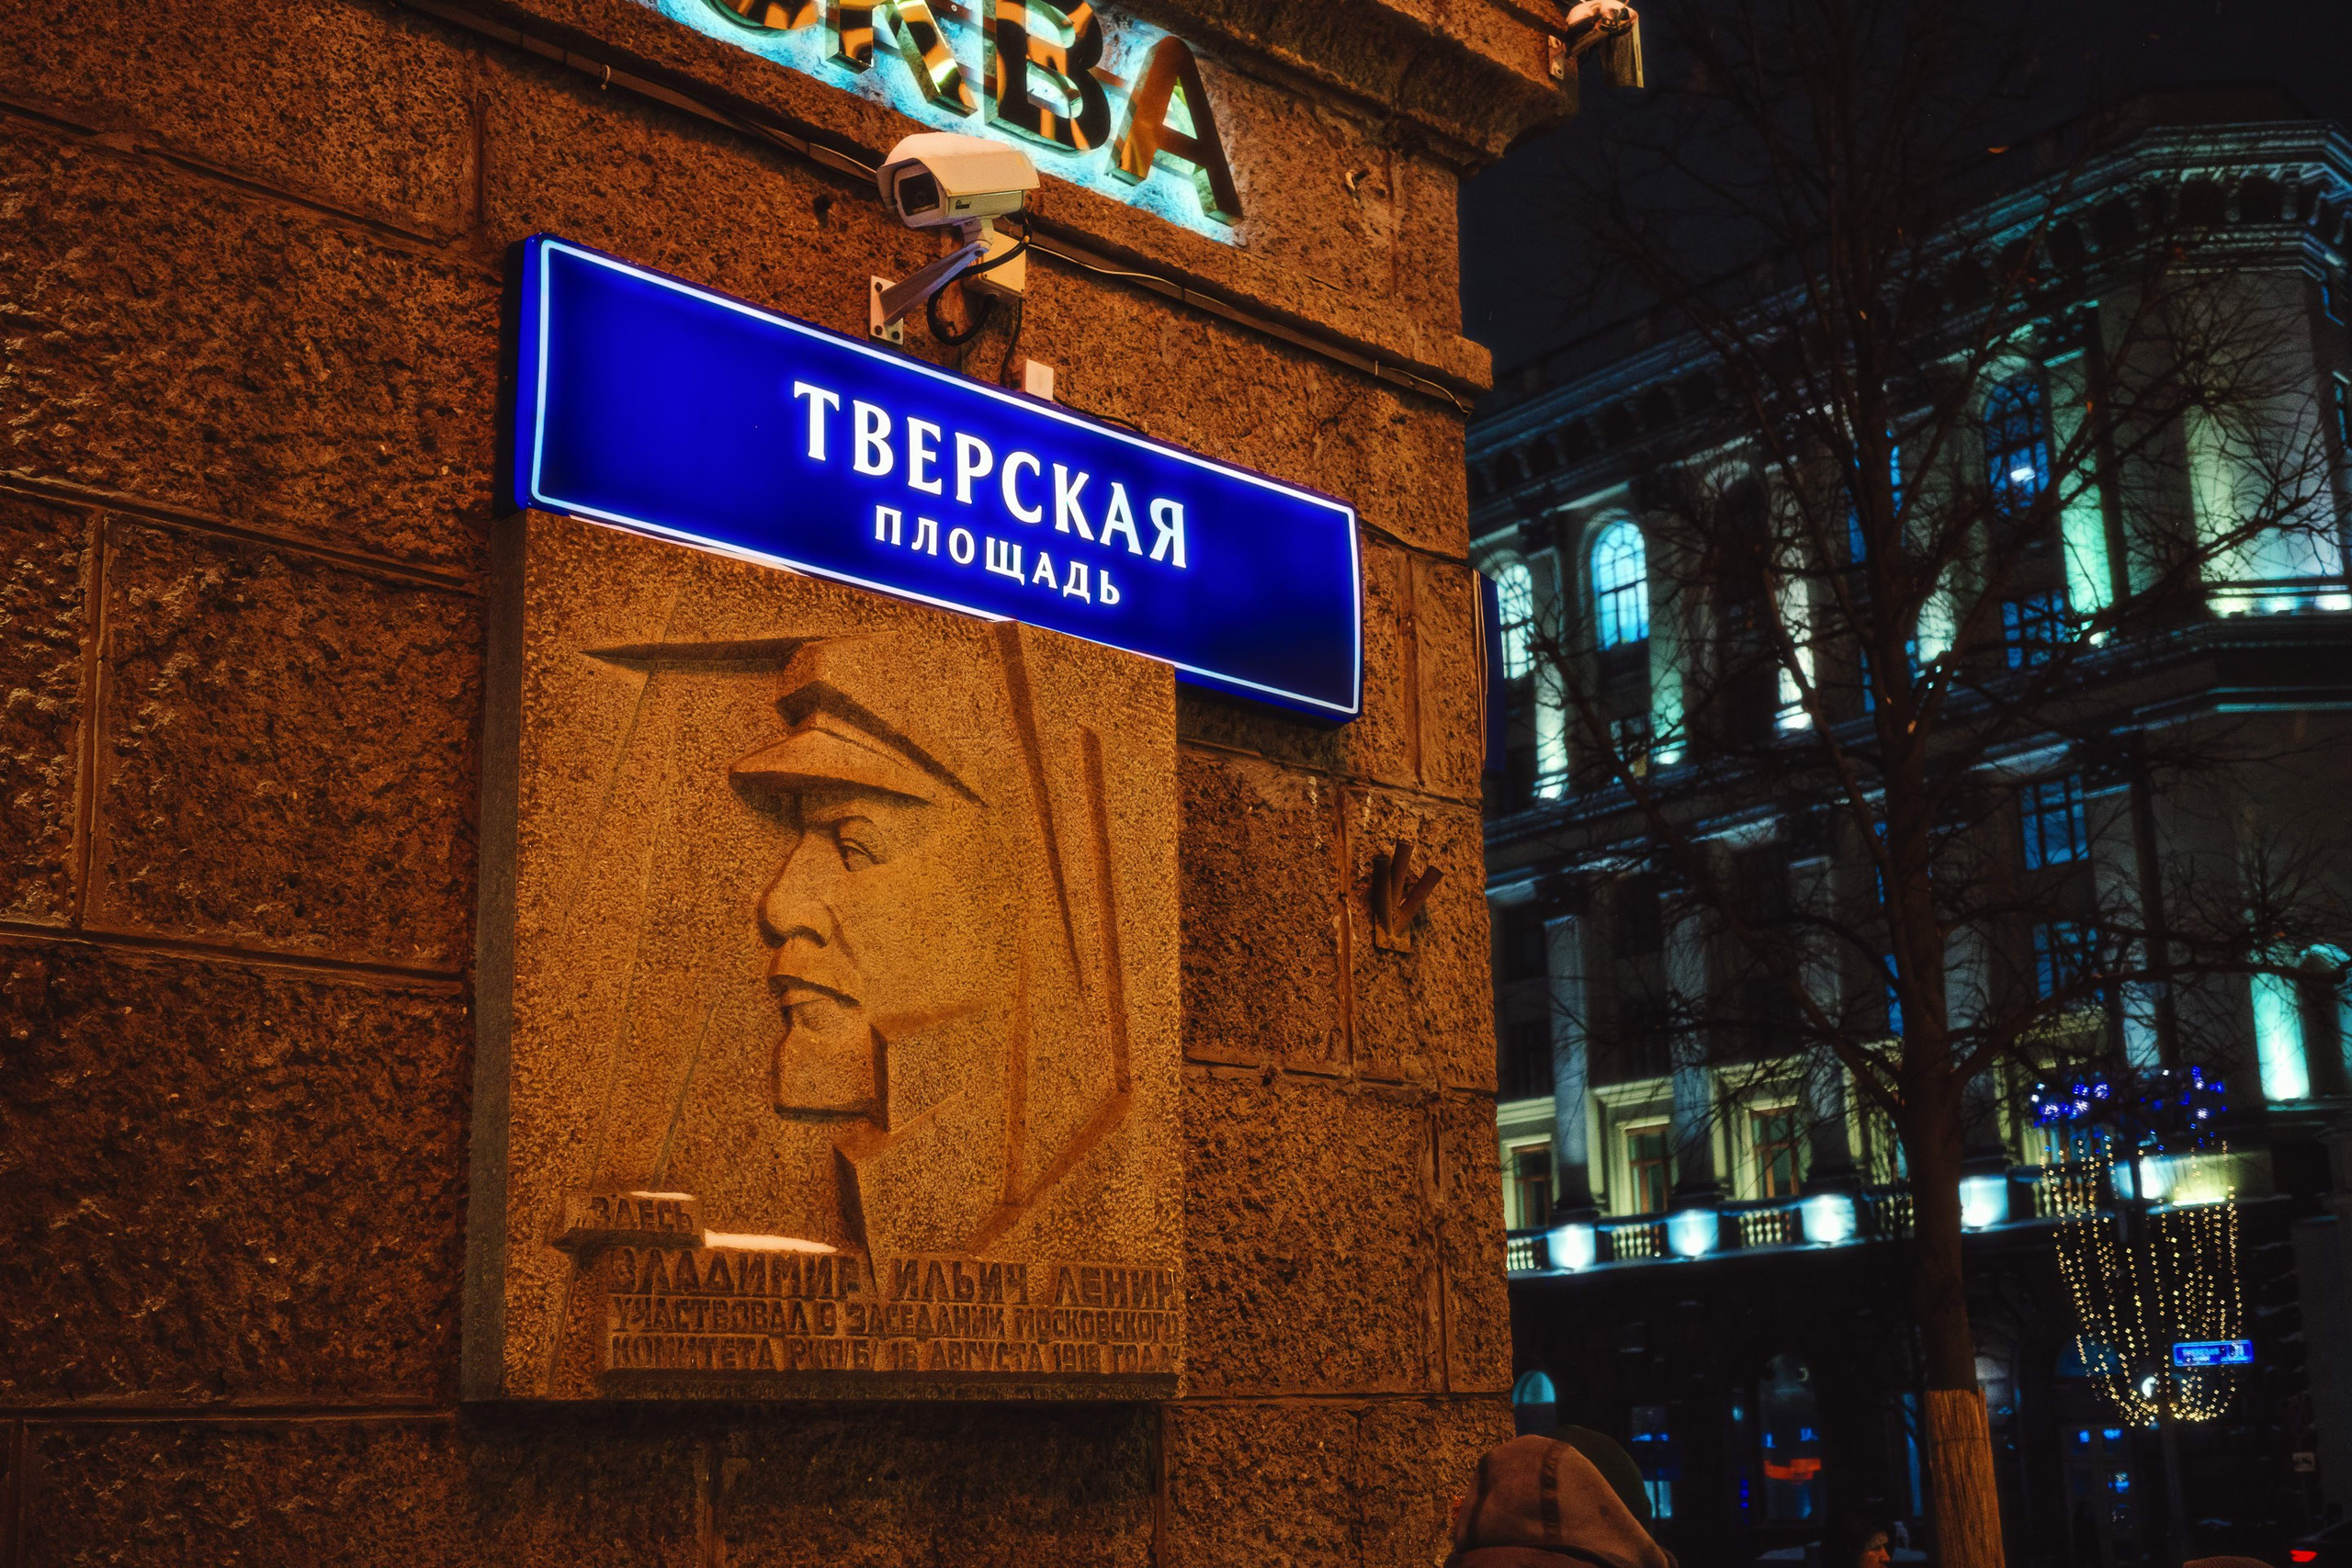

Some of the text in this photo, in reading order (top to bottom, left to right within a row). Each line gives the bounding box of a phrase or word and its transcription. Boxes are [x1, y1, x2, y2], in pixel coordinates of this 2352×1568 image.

[793, 380, 1187, 569] ТВЕРСКАЯ
[875, 504, 1120, 604] ПЛОЩАДЬ
[608, 1247, 1177, 1309] ВЛАДИМИР ИЛЬИЧ ЛЕНИН
[613, 1296, 808, 1334] УЧАСТВОВАЛ
[845, 1303, 1004, 1339] ЗАСЕДАНИИ
[1014, 1308, 1179, 1343] МОСКОВСКОГО
[612, 1336, 774, 1368] КОМИТЕТА
[932, 1341, 1041, 1371] АВГУСТА
[1054, 1344, 1100, 1371] 1918
